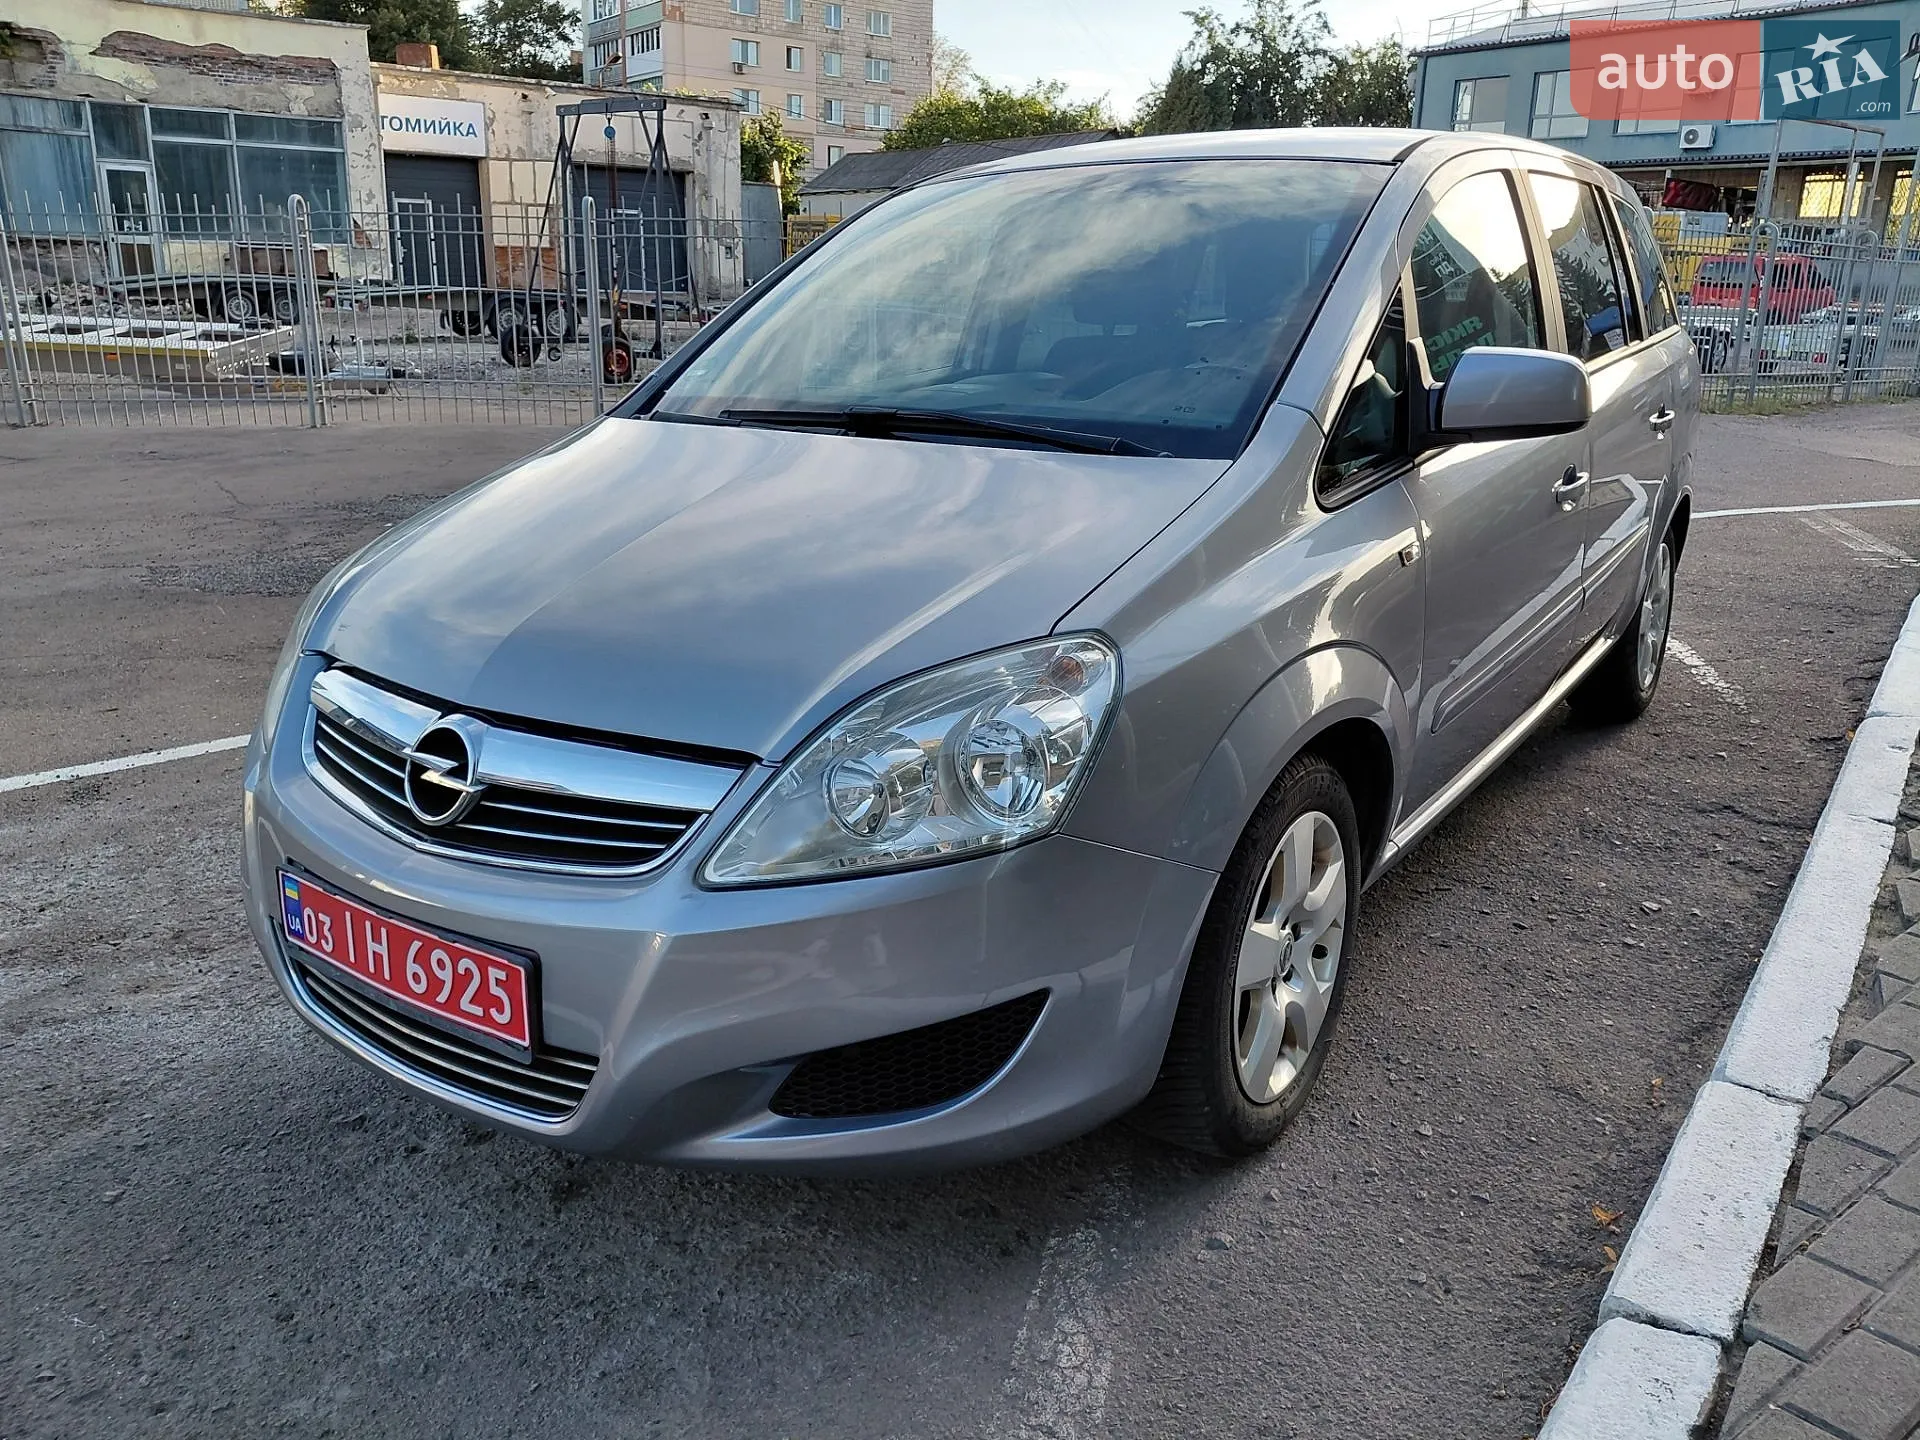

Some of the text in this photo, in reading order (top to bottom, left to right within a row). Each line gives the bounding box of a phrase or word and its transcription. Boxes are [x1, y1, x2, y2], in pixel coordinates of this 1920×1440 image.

[287, 913, 303, 935] UA
[303, 907, 334, 953] 03
[406, 940, 512, 1025] 6925
